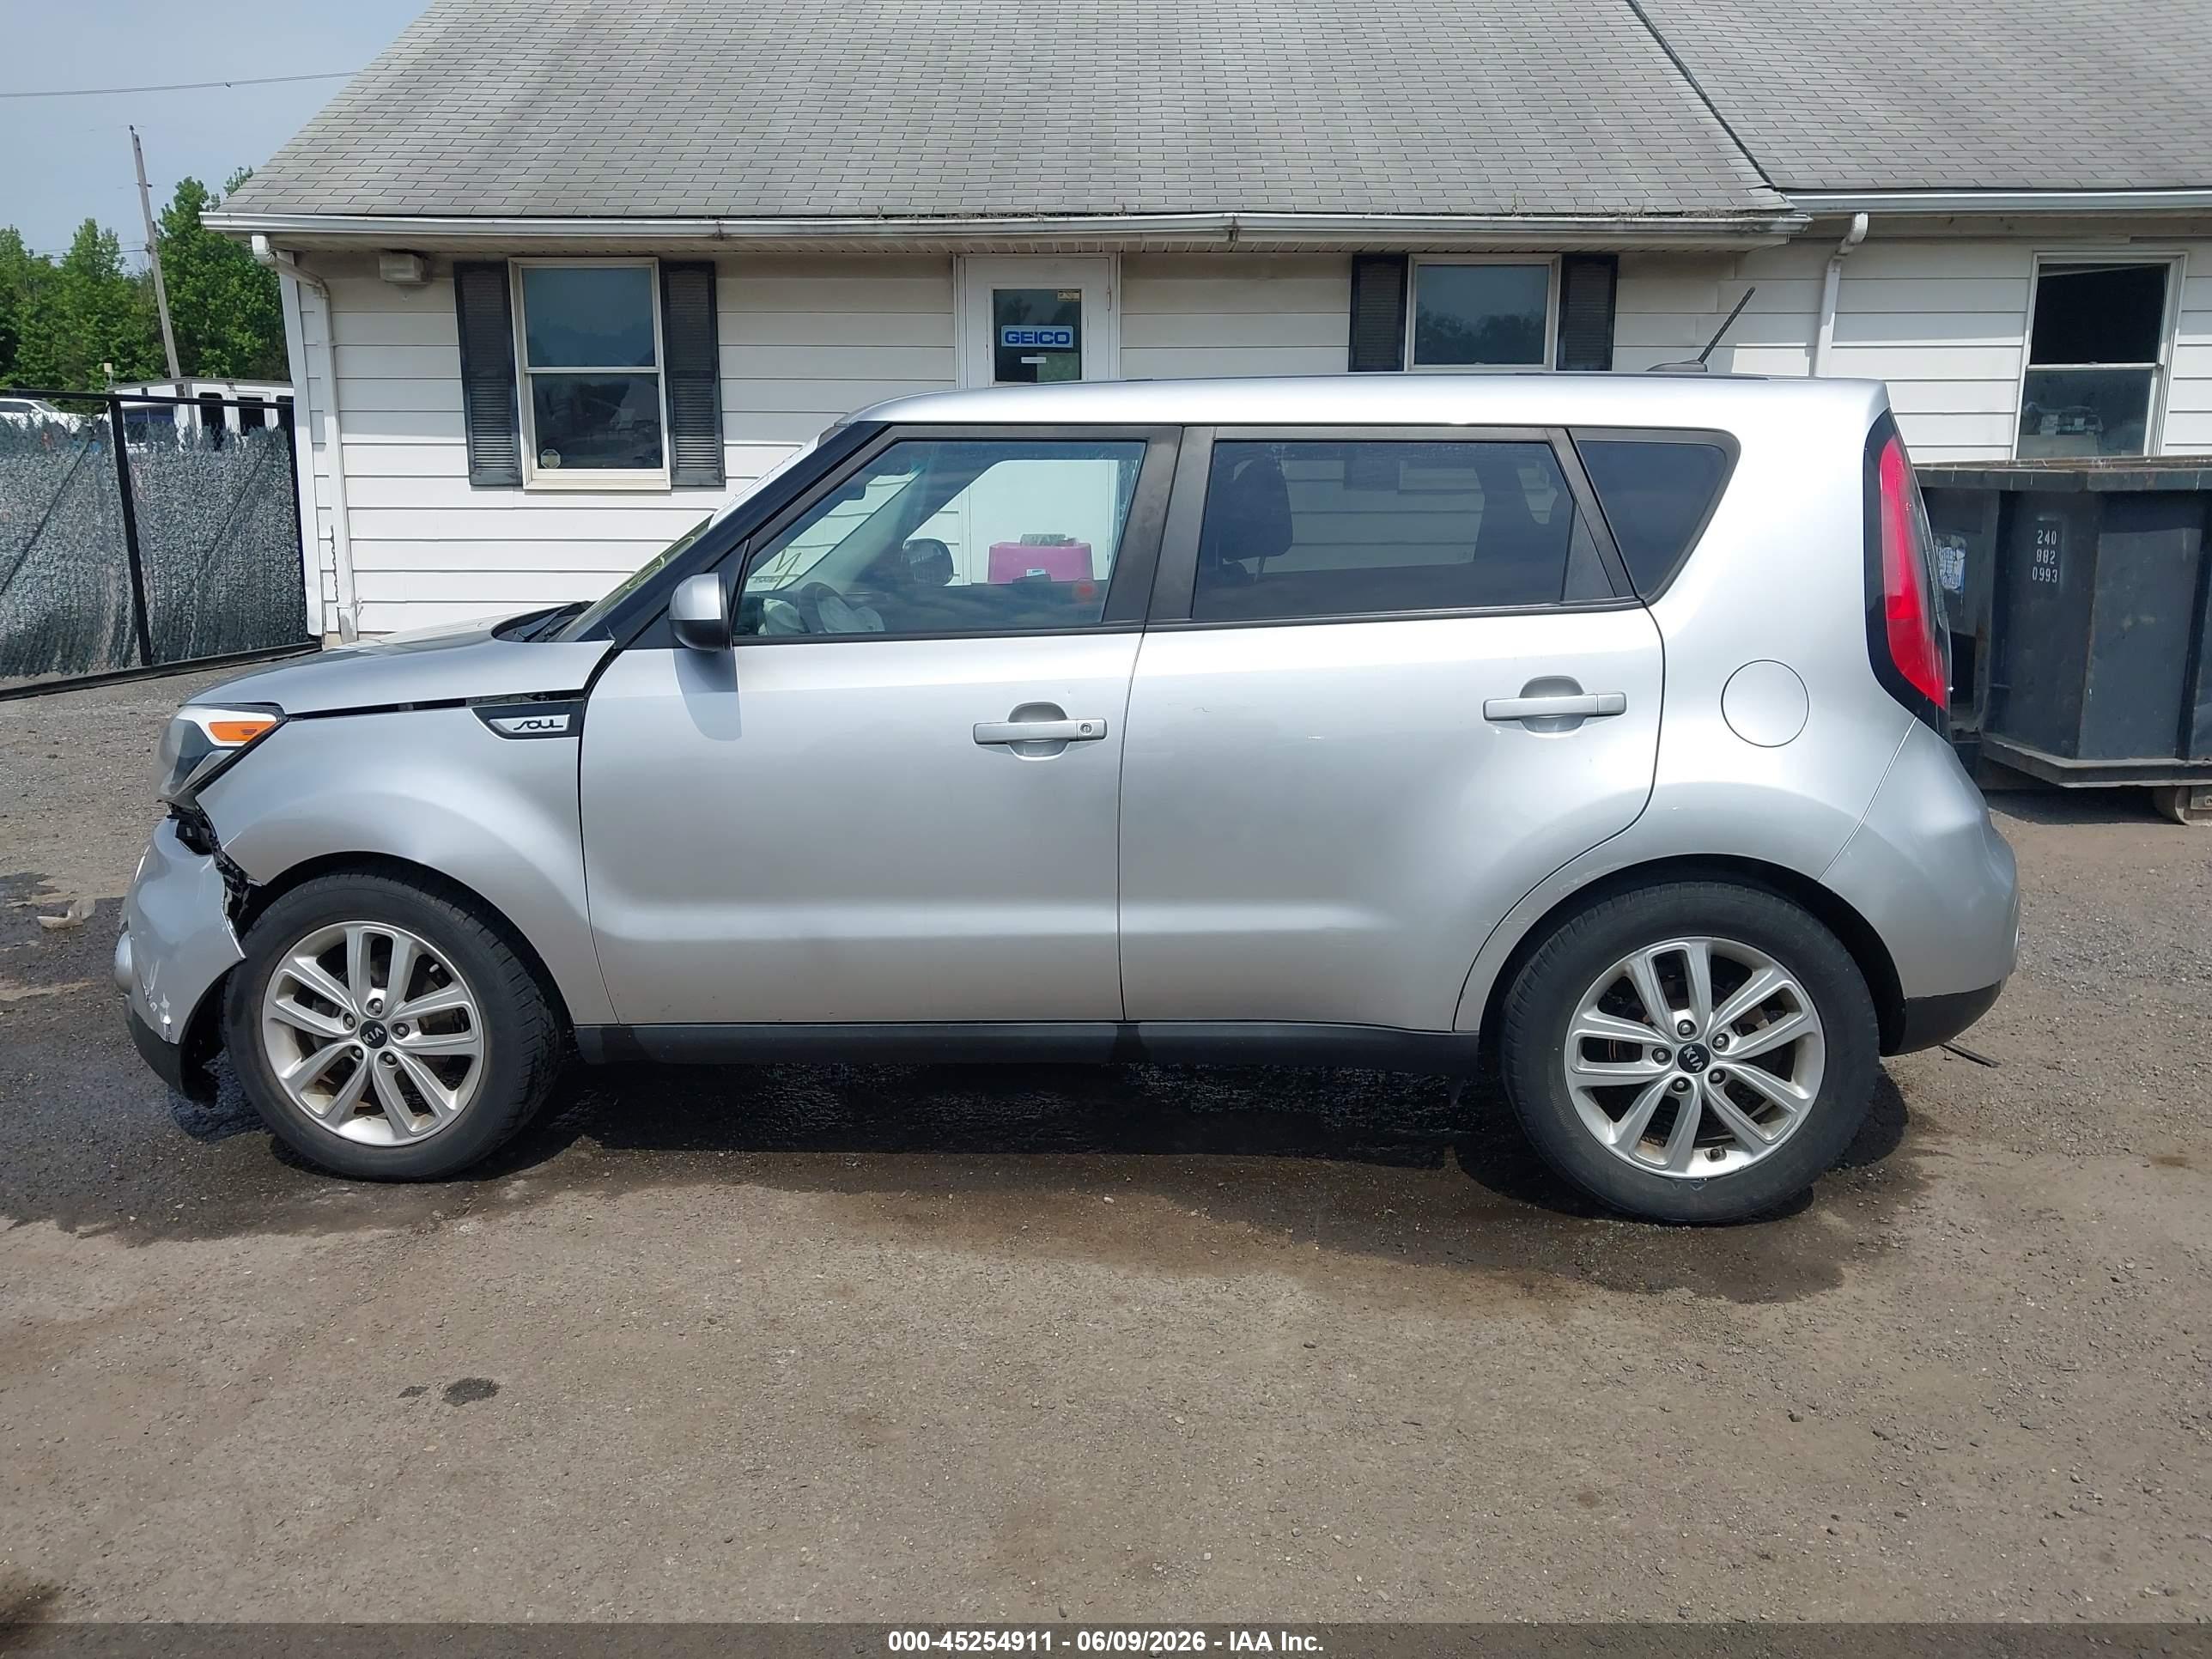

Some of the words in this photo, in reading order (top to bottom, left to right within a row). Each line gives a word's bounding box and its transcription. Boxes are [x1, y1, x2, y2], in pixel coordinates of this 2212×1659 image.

[1005, 331, 1071, 344] GEICO
[2037, 529, 2057, 545] 240
[2036, 549, 2056, 565] 882
[2032, 566, 2058, 583] 0993
[362, 1027, 385, 1045] KIA
[1683, 1045, 1704, 1072] KIA
